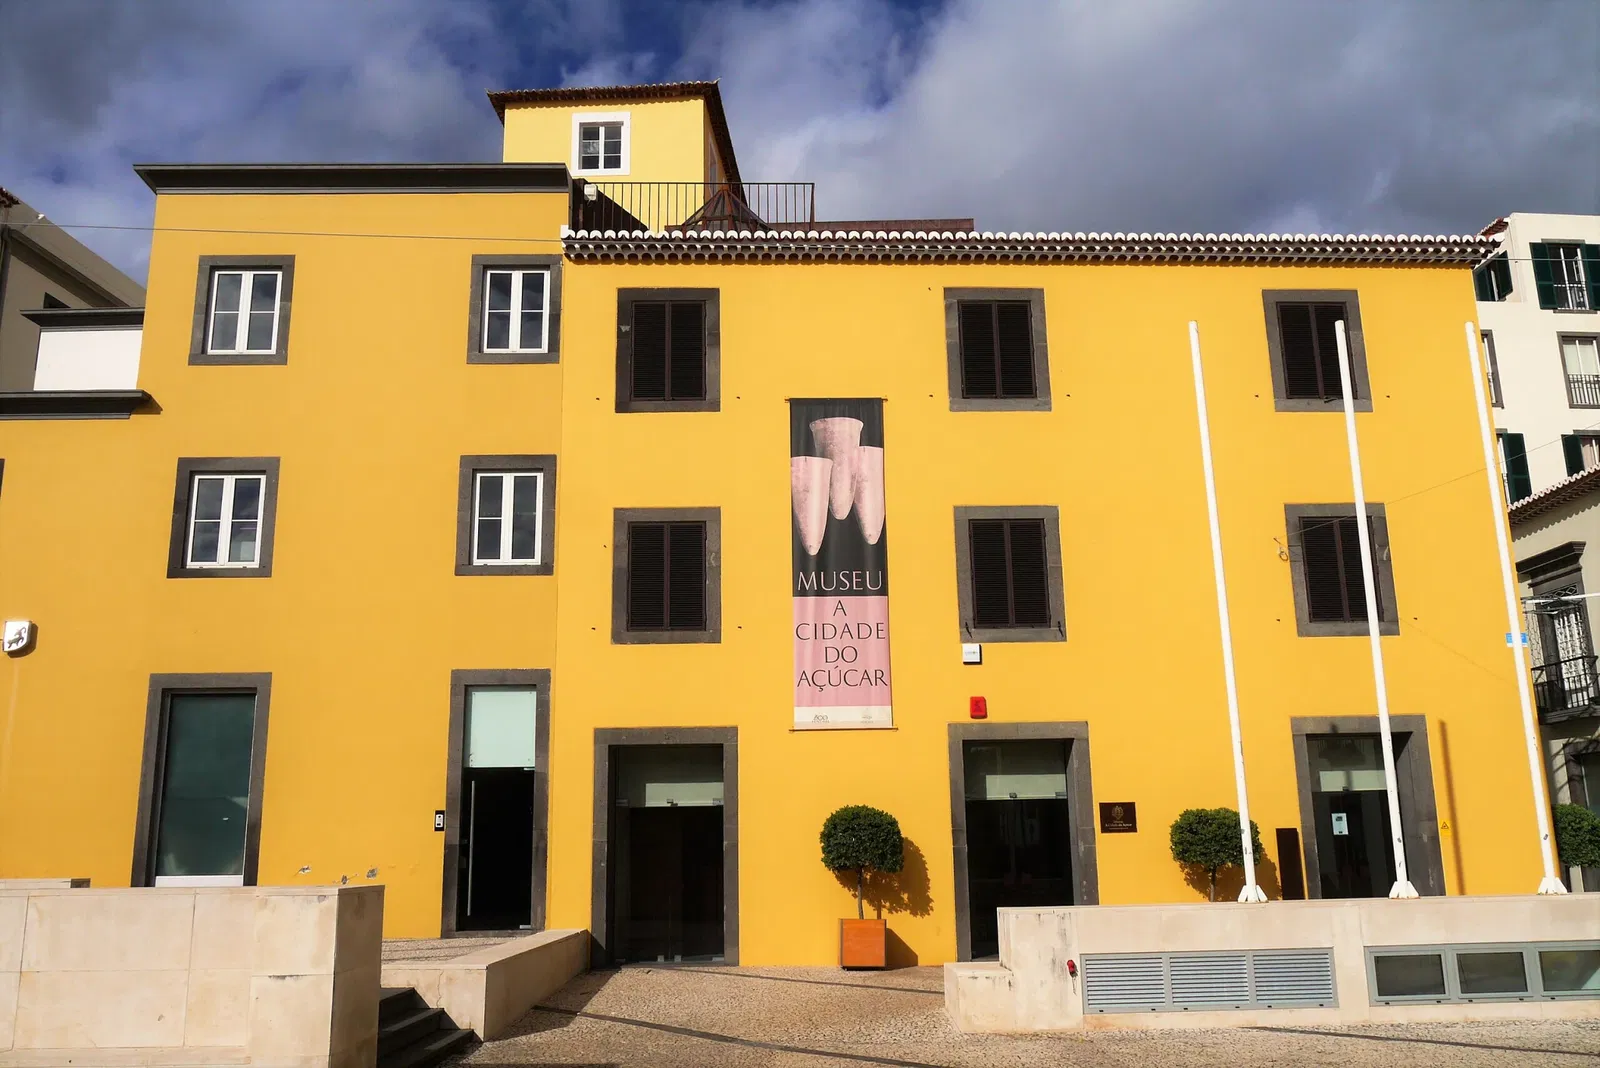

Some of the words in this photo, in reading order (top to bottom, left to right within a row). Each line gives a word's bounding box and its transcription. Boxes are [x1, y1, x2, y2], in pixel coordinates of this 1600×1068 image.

[797, 570, 882, 591] MUSEU
[833, 600, 847, 616] A
[795, 622, 886, 640] CIDADE
[824, 645, 858, 663] DO
[797, 666, 888, 692] AÇÚCAR
